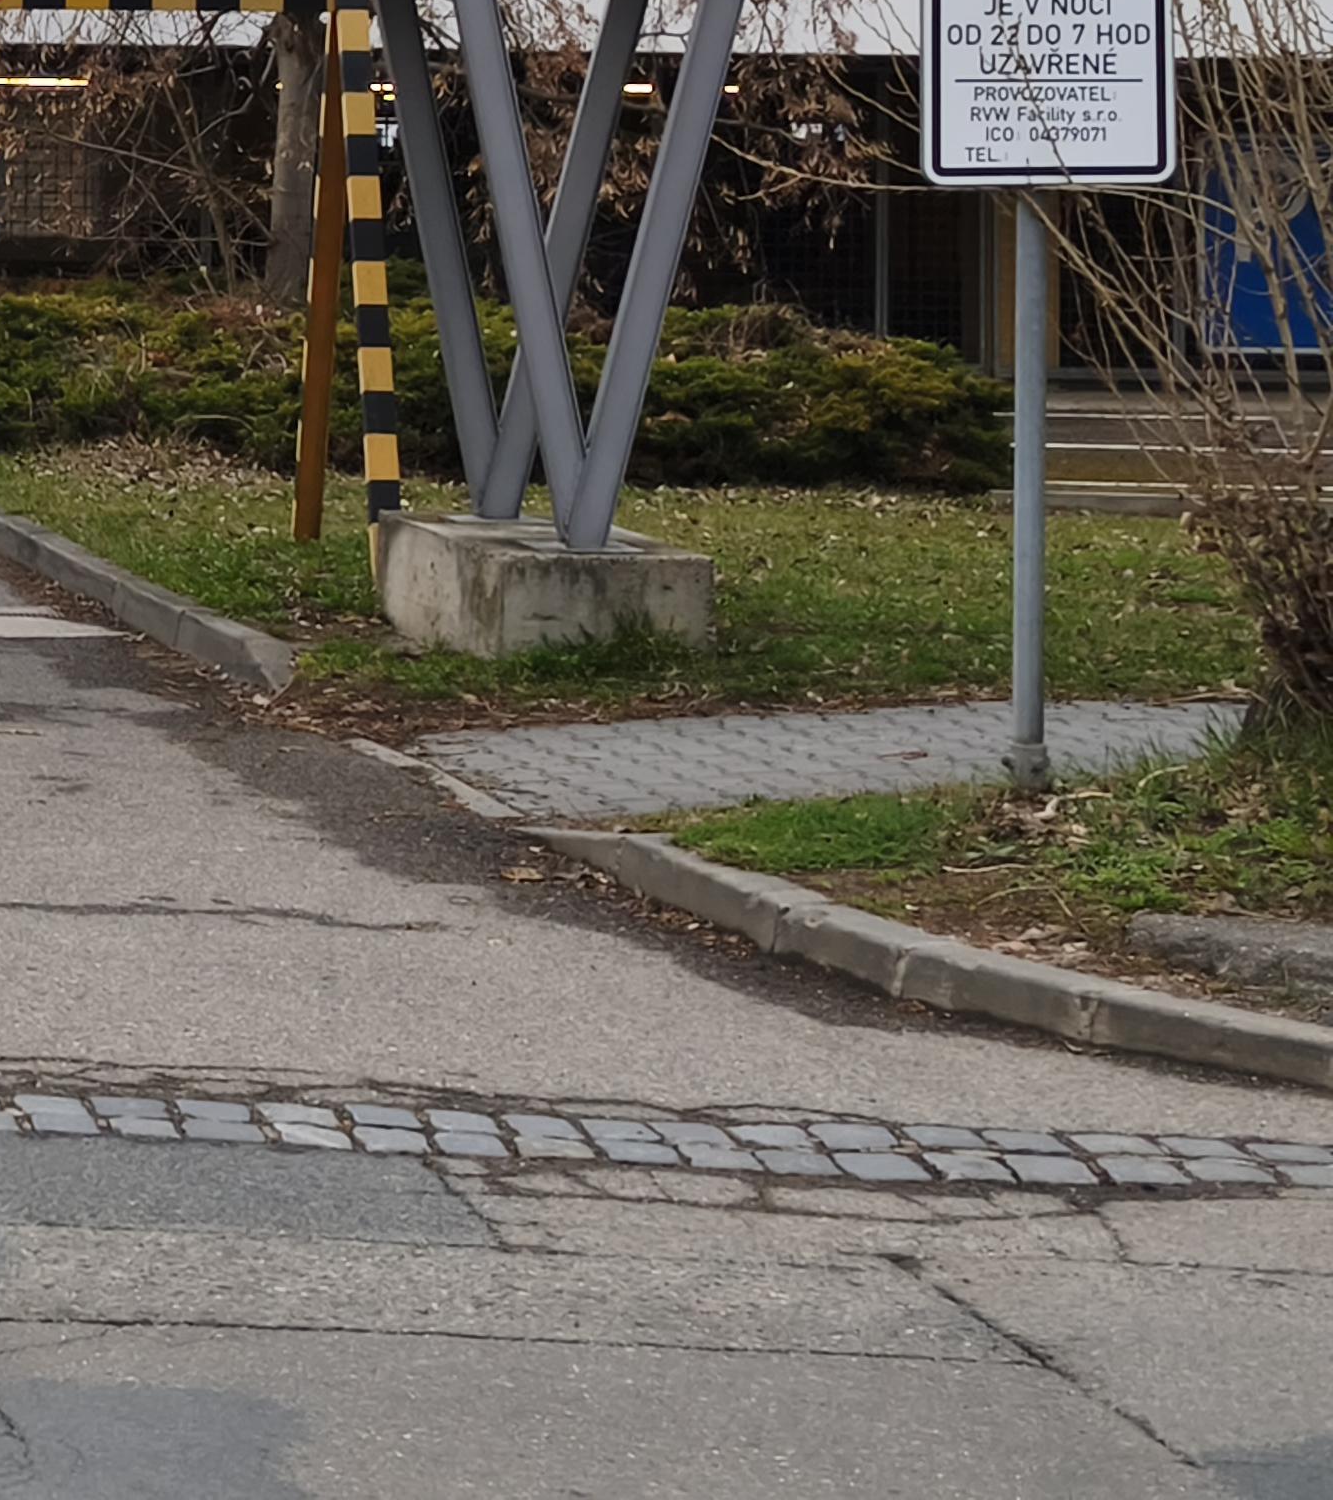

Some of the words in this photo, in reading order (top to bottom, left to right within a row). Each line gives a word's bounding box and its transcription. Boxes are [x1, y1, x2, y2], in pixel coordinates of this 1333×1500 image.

[947, 25, 981, 45] OD
[991, 24, 1019, 45] 22
[1027, 24, 1061, 45] DO
[1073, 24, 1085, 45] 7
[1097, 23, 1150, 45] HOD
[980, 48, 1117, 74] UZAVŘENÉ
[970, 106, 1010, 121] RVW
